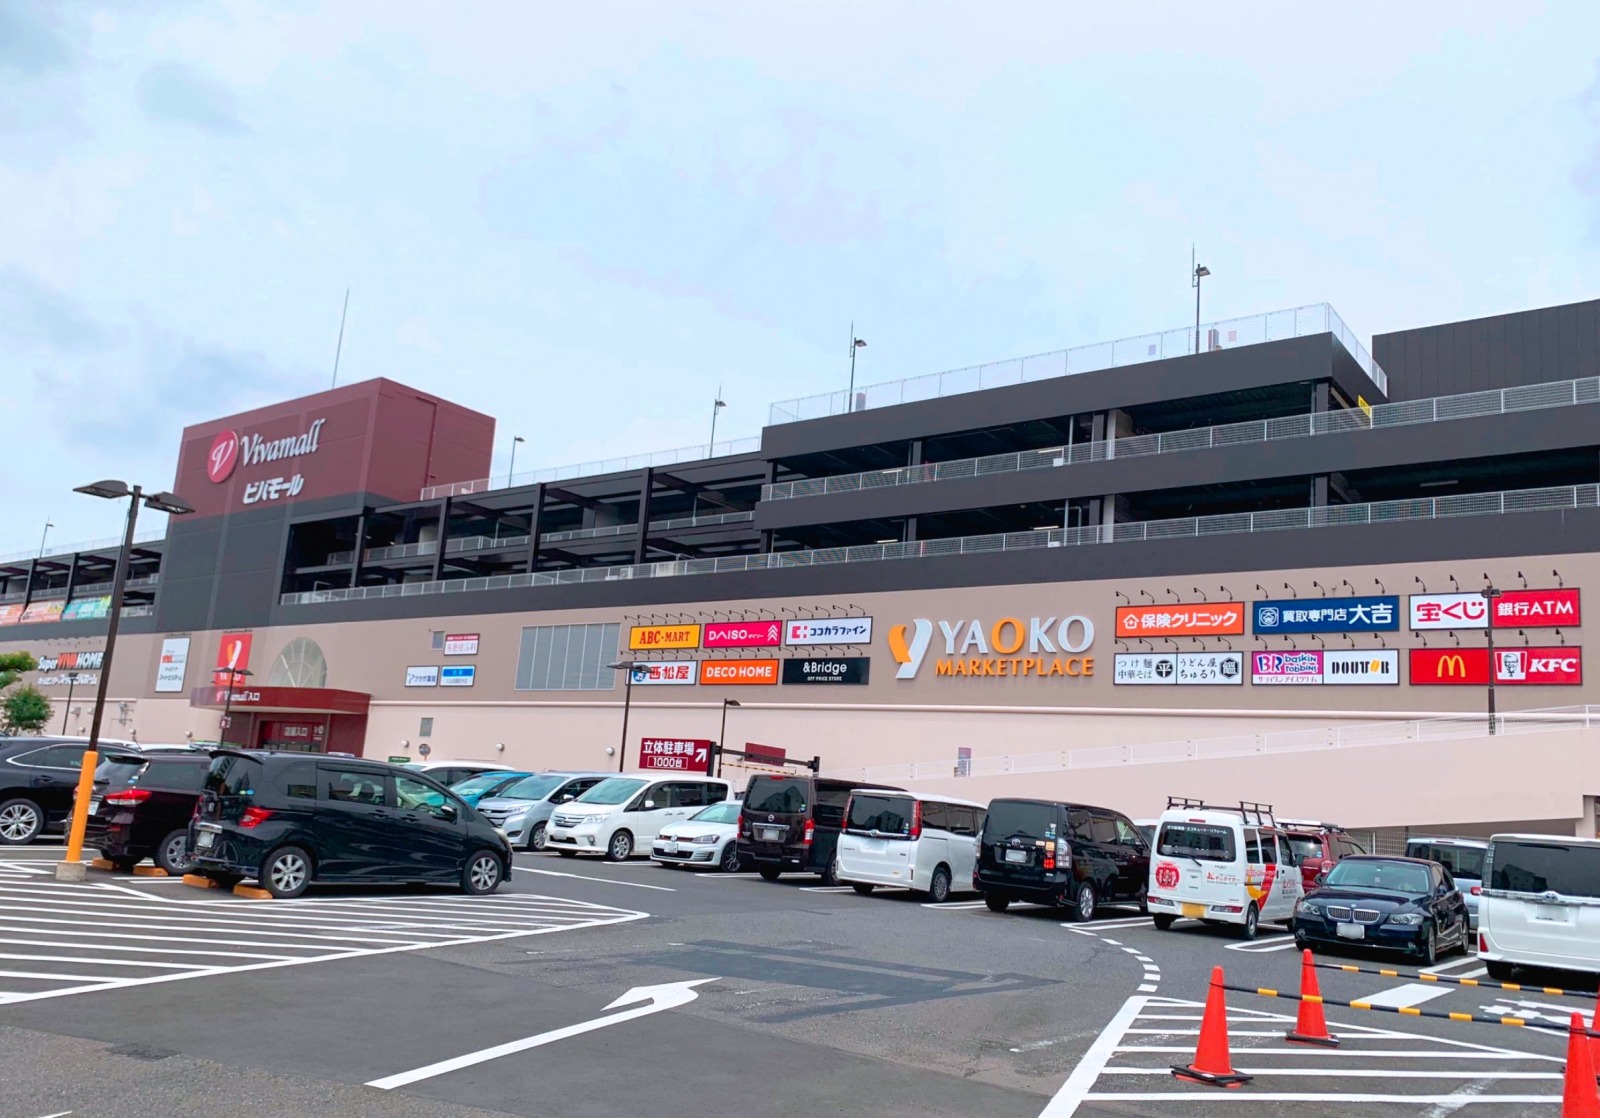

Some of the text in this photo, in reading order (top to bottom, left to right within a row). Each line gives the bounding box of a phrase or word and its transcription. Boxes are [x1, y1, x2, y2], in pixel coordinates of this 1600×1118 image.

[240, 418, 326, 466] Vivamall
[243, 474, 305, 504] ビバモール
[1282, 603, 1393, 624] 買取専門店 大吉
[1416, 601, 1485, 622] 宝くじ
[1497, 600, 1574, 616] 銀行ATM
[1141, 611, 1238, 629] 保険クリニック
[639, 630, 690, 644] ABC-MART
[708, 629, 747, 641] DAISO
[809, 624, 867, 637] ココカラファイン
[937, 614, 1095, 654] YAOKO
[802, 661, 848, 676] &Bridge
[935, 656, 1095, 677] MARKETPLACE
[1180, 657, 1217, 668] うどん屋
[1331, 659, 1389, 674] DOUTOR
[1529, 658, 1577, 673] KFC
[649, 665, 690, 680] 西松屋
[706, 666, 773, 678] DECO HOME
[1180, 669, 1217, 680] ちゅるり
[643, 740, 694, 755] 立体駐車場
[653, 757, 682, 768] 1000台
